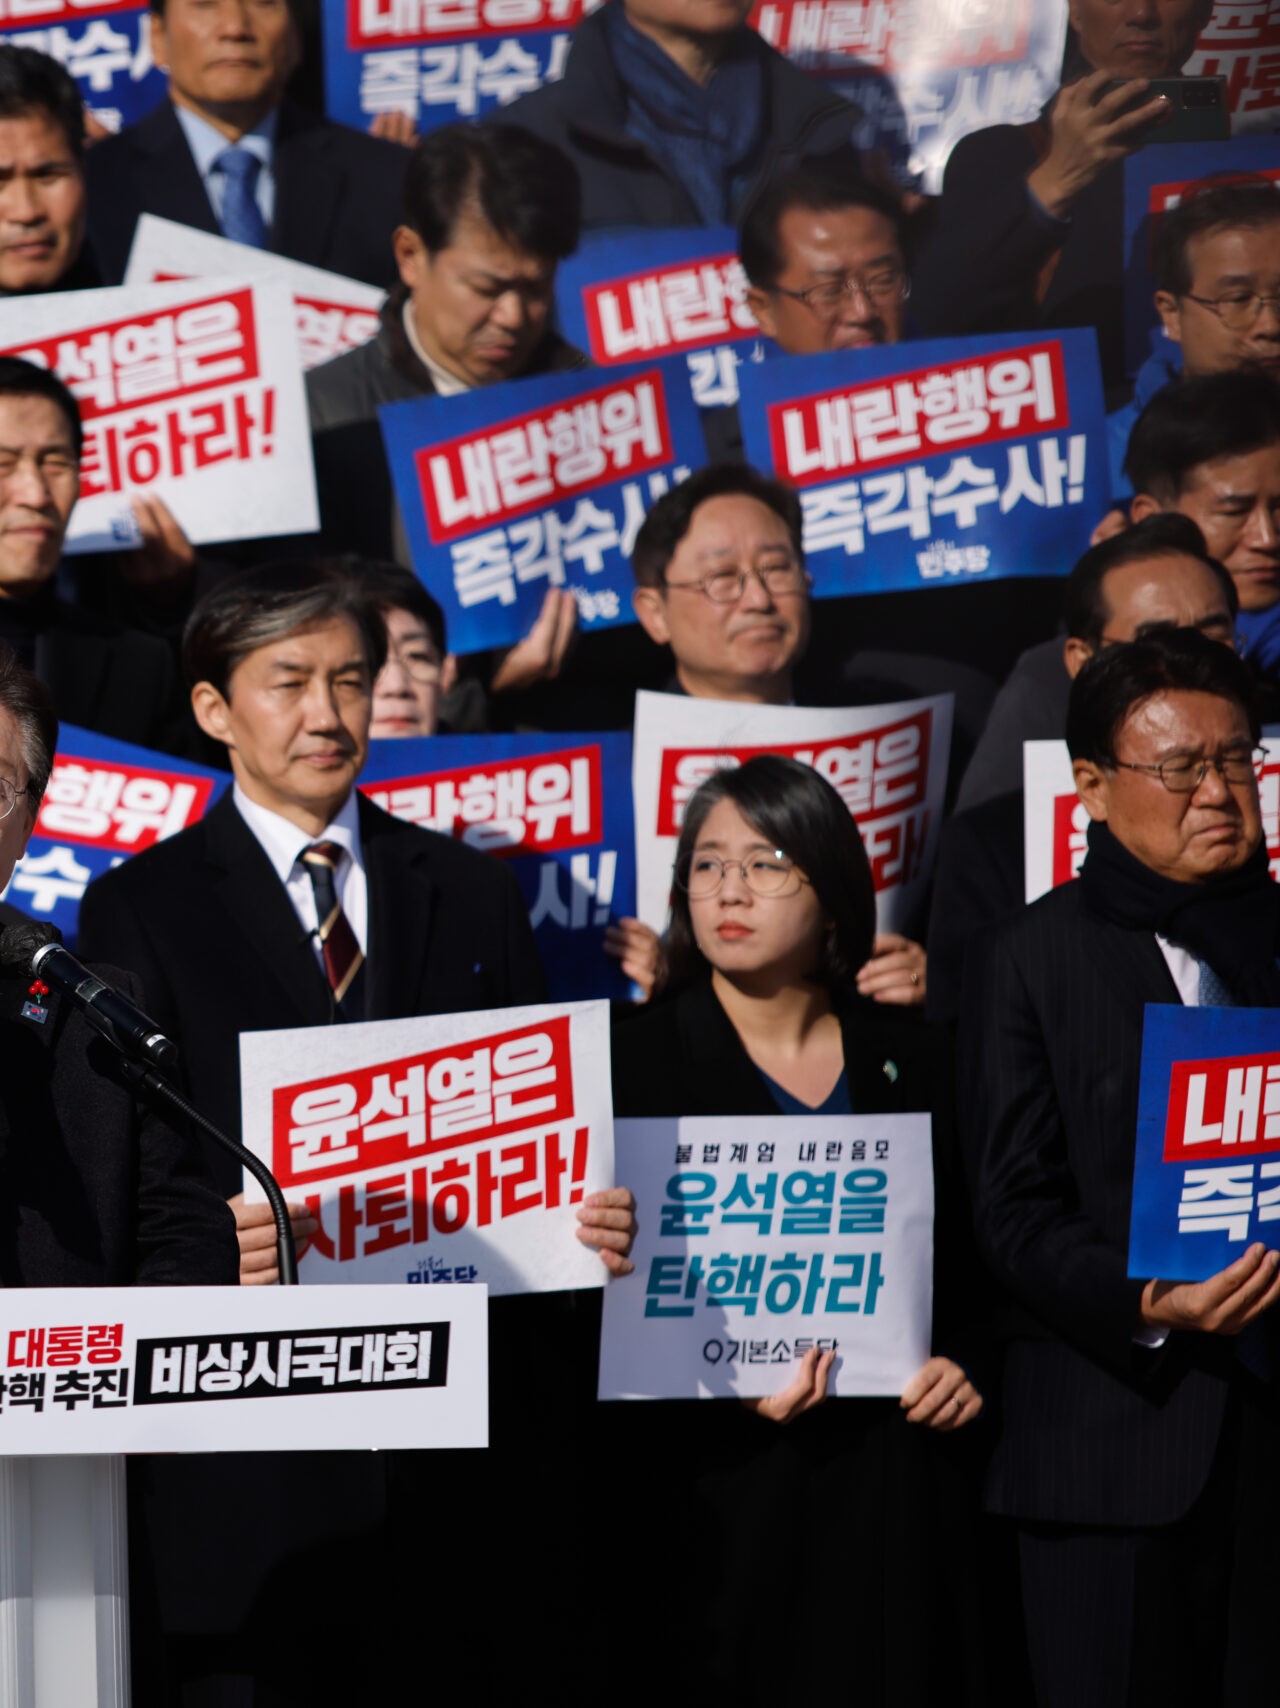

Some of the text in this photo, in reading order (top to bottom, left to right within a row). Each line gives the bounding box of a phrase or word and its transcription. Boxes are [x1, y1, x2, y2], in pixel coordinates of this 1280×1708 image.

[10, 299, 246, 410] 석열은
[429, 379, 664, 528] 내란행위
[781, 350, 1057, 477] 내란행위
[799, 433, 1088, 556] 즉각수사!
[370, 756, 591, 852] 란행위
[288, 1031, 558, 1175] 윤석열은
[297, 1126, 590, 1263] 사퇴하라!
[659, 1167, 888, 1238] 윤석열을
[643, 1252, 885, 1319] 탄핵하라
[7, 1323, 124, 1368] 대통령
[53, 1367, 130, 1411] 추진
[149, 1329, 433, 1395] 비상시국대회
